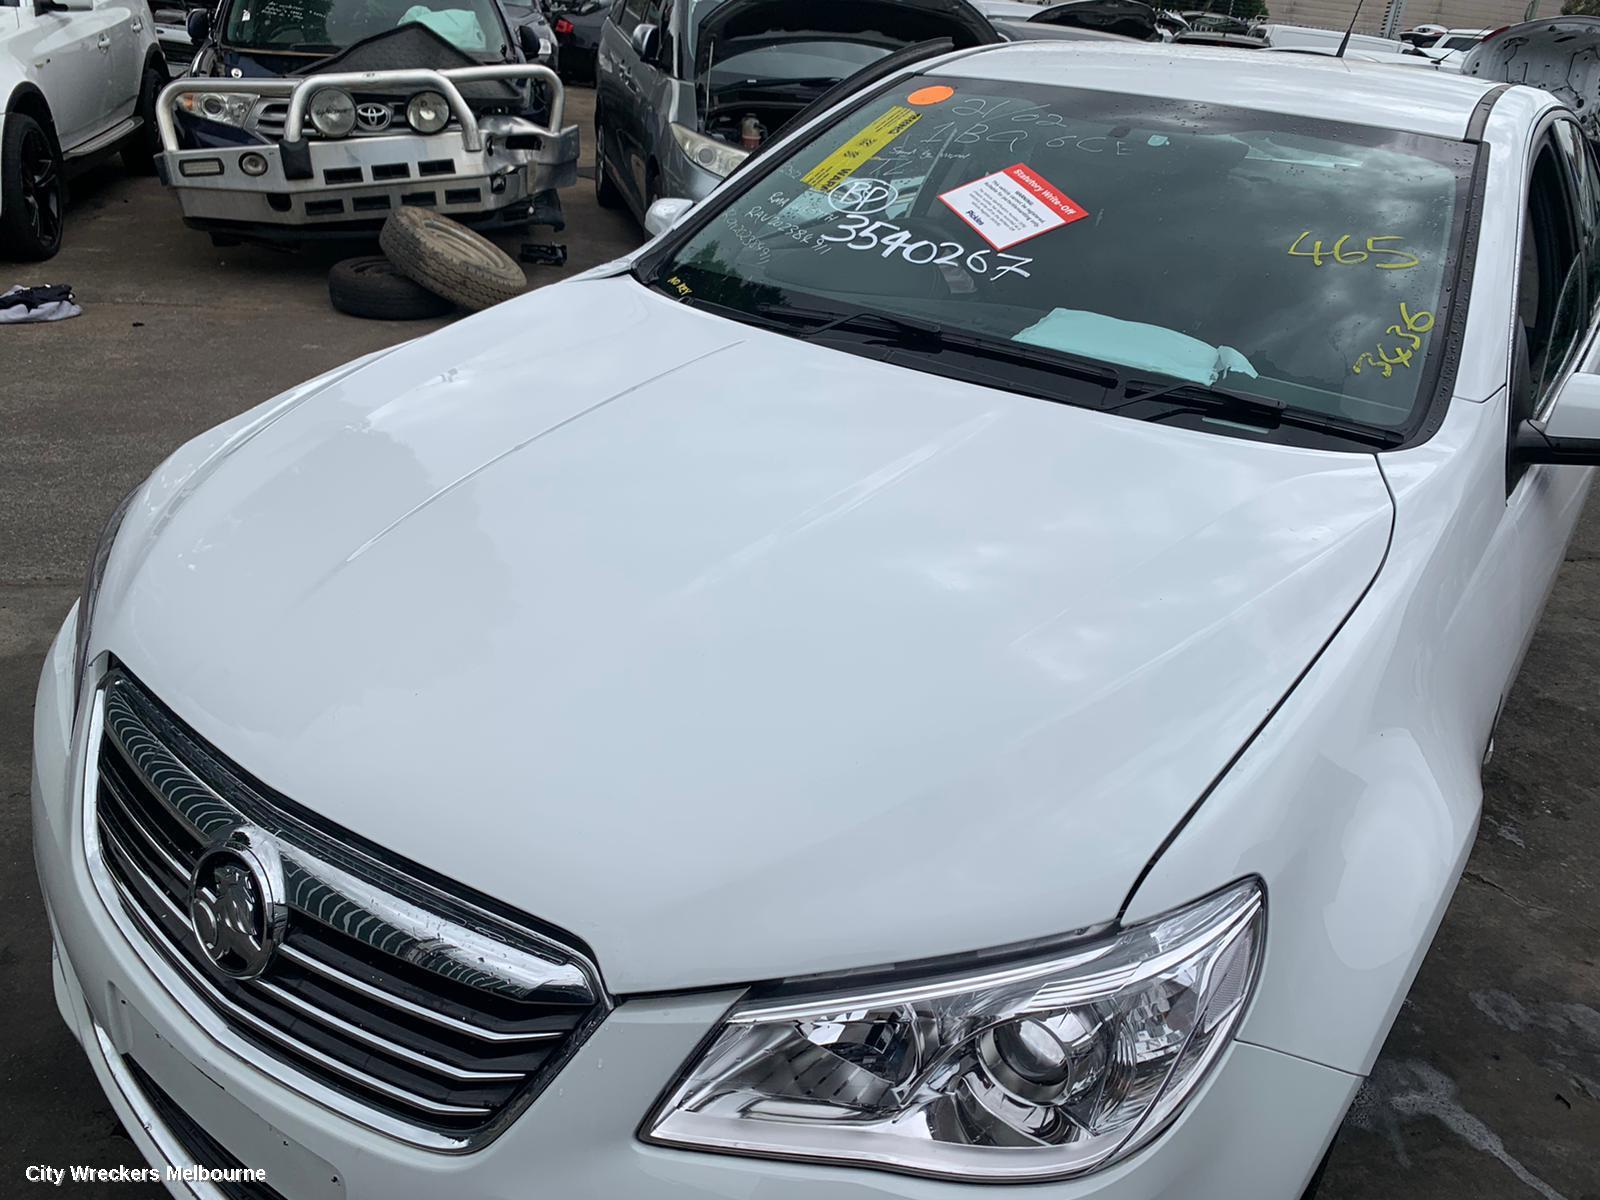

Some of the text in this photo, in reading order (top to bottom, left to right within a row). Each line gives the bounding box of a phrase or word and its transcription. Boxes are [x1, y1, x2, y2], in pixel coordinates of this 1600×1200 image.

[1013, 168, 1044, 192] Statutory
[1041, 190, 1077, 215] Write-Off
[821, 213, 1034, 281] 3540267
[1287, 231, 1420, 270] 465
